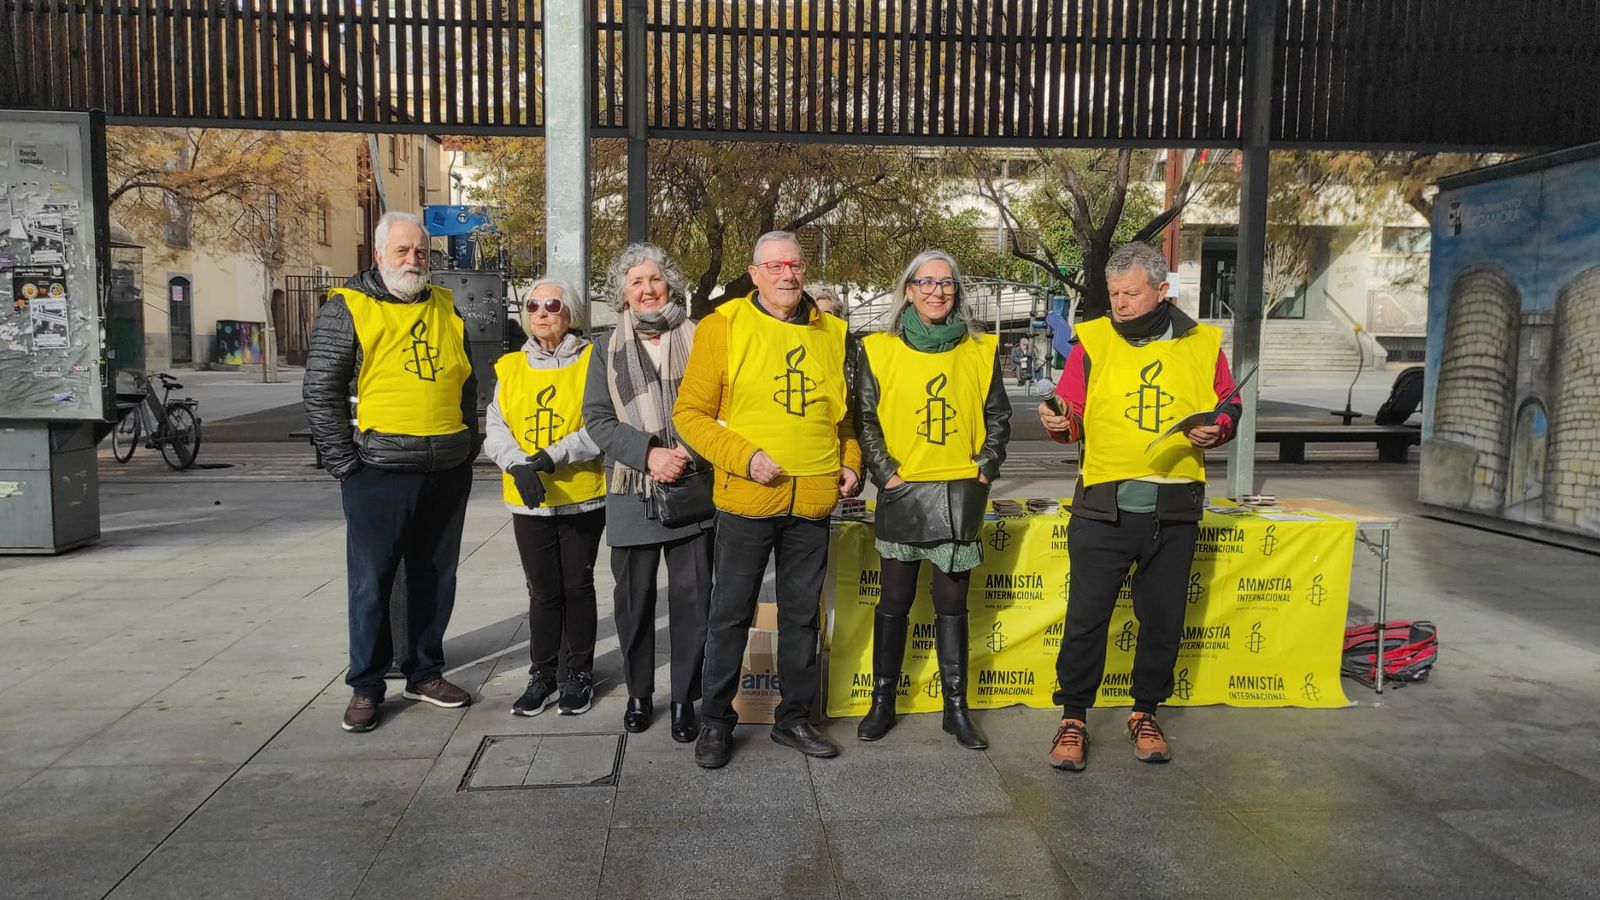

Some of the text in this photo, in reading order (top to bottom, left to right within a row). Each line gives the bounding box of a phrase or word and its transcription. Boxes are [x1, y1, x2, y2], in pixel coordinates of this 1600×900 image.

[1196, 525, 1244, 542] MNISTÍA
[1195, 543, 1244, 554] TERNACIONAL
[985, 572, 1043, 589] AMNISTÍA
[1237, 574, 1292, 592] AMNISTÍA
[984, 590, 1044, 601] INTERNACIONAL
[1237, 592, 1290, 603] INTERNACIONAL
[1179, 641, 1230, 650] NTERNACIONAL
[741, 669, 780, 690] arie
[978, 668, 1035, 685] AMNISTÍA
[1228, 673, 1285, 691] AMNISTÍA
[977, 686, 1034, 696] INTERNACIONAL
[1228, 691, 1288, 701] INTERNACIONAL
